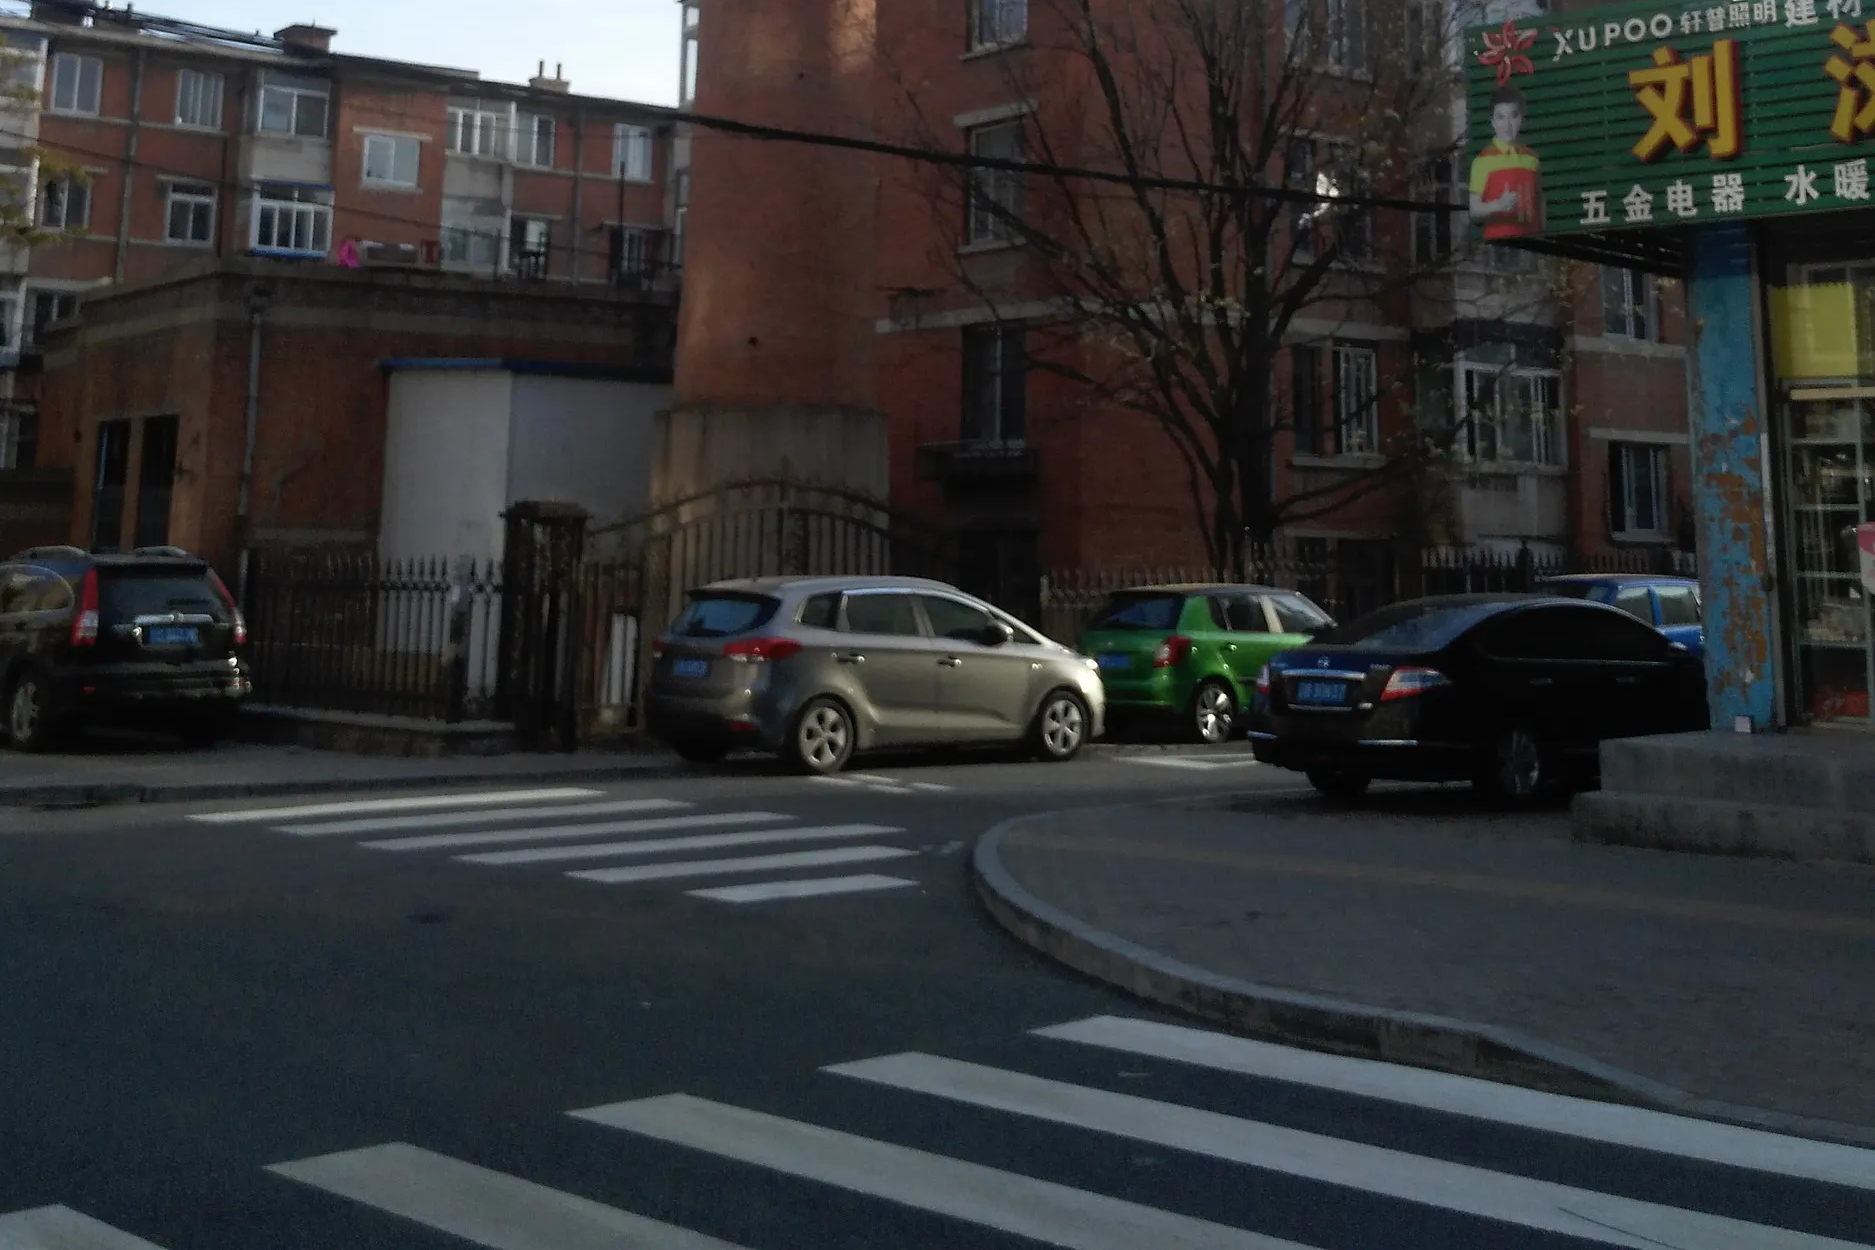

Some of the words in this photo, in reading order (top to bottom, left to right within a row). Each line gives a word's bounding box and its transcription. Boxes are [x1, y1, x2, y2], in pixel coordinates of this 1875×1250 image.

[1553, 13, 1672, 61] XUPOO
[1629, 38, 1741, 162] 刘
[1580, 174, 1744, 225] 五金电器
[1785, 160, 1870, 205] 水暖
